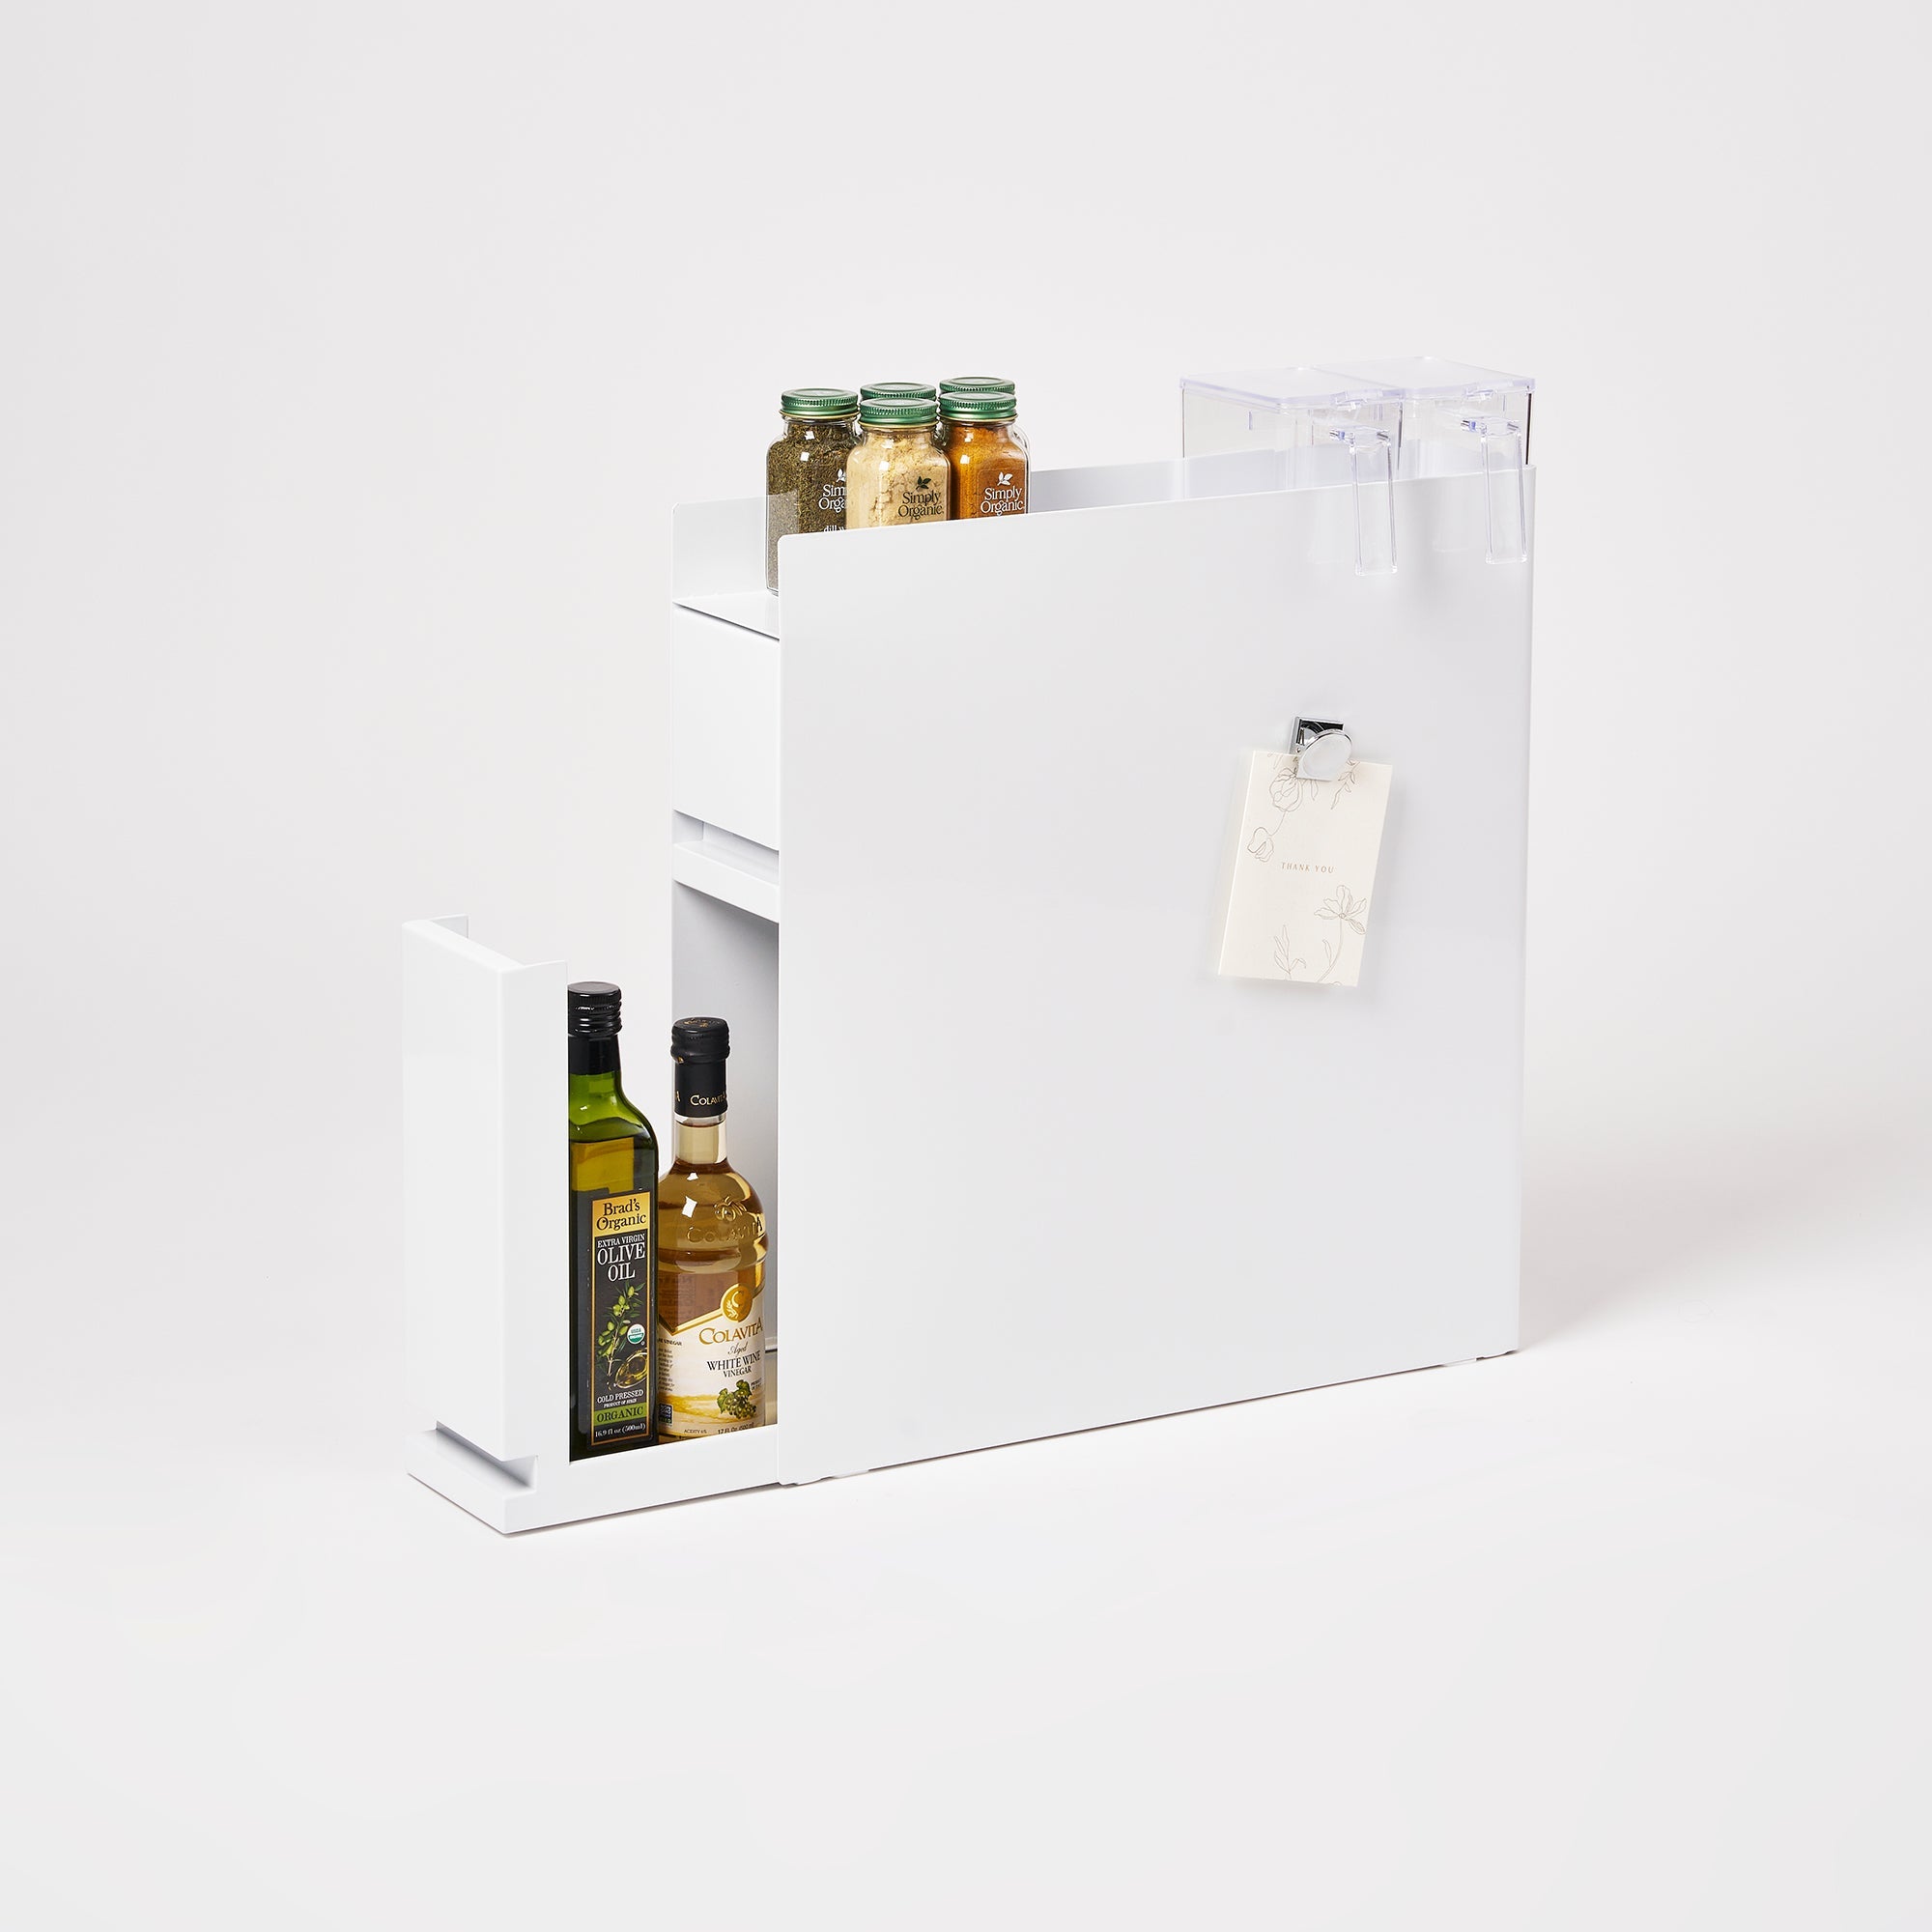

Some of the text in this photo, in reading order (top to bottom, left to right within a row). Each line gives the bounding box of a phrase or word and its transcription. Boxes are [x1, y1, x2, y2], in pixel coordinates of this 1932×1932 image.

[822, 484, 845, 497] Sim
[902, 489, 941, 506] Simply
[984, 485, 1022, 503] Simply
[818, 497, 845, 513] Orga
[897, 504, 942, 521] Organic
[980, 499, 1023, 516] Organic
[1281, 862, 1334, 873] THANK YOU
[604, 1198, 640, 1216] Brad's
[596, 1213, 646, 1231] Organic
[597, 1233, 645, 1248] EXTRA VIRGIN
[597, 1241, 645, 1265] OLIVE
[608, 1262, 636, 1282] OIL
[698, 1317, 763, 1345] COLAVITA
[727, 1341, 749, 1358] Aged
[706, 1350, 761, 1371] WHITE WINE
[723, 1365, 752, 1378] VINEGAR
[597, 1389, 644, 1404] COLD PRESSED
[596, 1406, 644, 1423] ORGANIC
